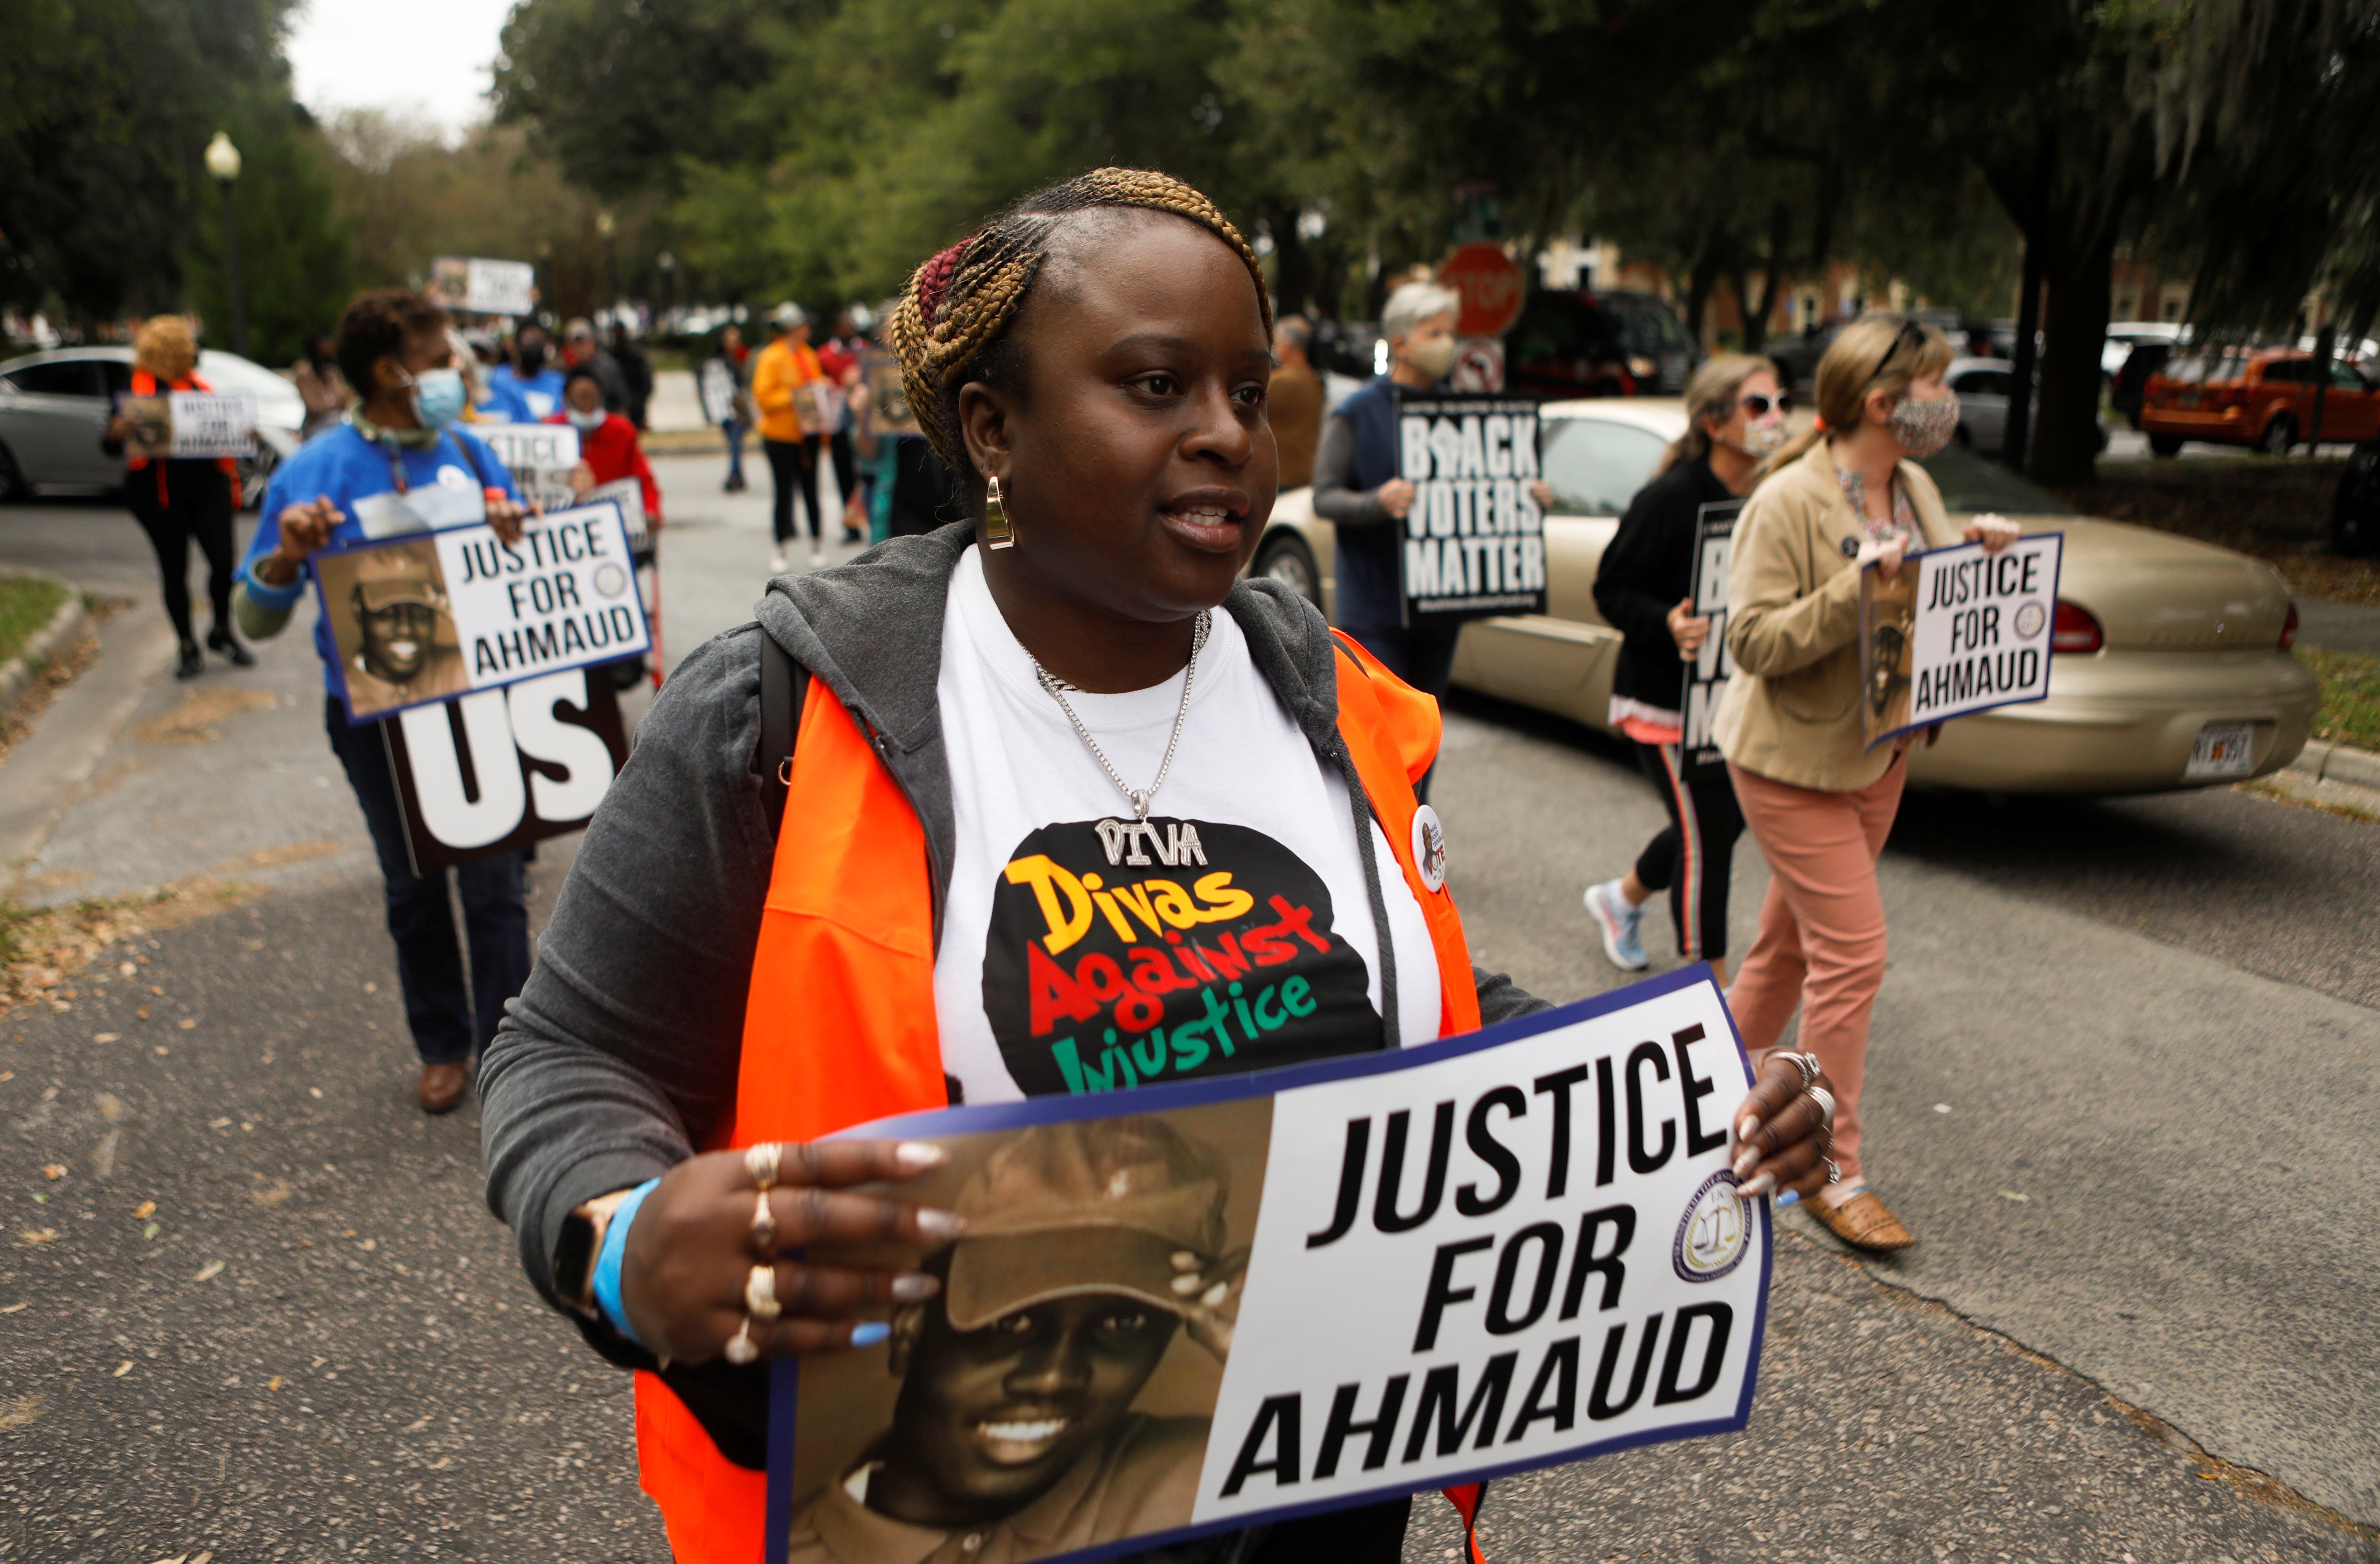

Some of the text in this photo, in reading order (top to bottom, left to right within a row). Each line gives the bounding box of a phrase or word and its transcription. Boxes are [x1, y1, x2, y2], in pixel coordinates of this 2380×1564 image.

[1409, 479, 1542, 538] VOTERS
[462, 519, 608, 583] JUSTICE
[1405, 535, 1545, 598] MATTER
[1927, 552, 2041, 611] JUSTICE
[507, 572, 580, 619] FOR
[476, 606, 634, 675] AHMAUD
[1951, 605, 2000, 654] FOR
[1916, 650, 2038, 712] AHMAUD
[1094, 818, 1208, 866] DIVA
[1005, 854, 1253, 955] Divas
[1305, 1022, 1727, 1250] JUSTICE
[1412, 1203, 1637, 1355] FOR
[1218, 1300, 1733, 1499] AHMAUD
